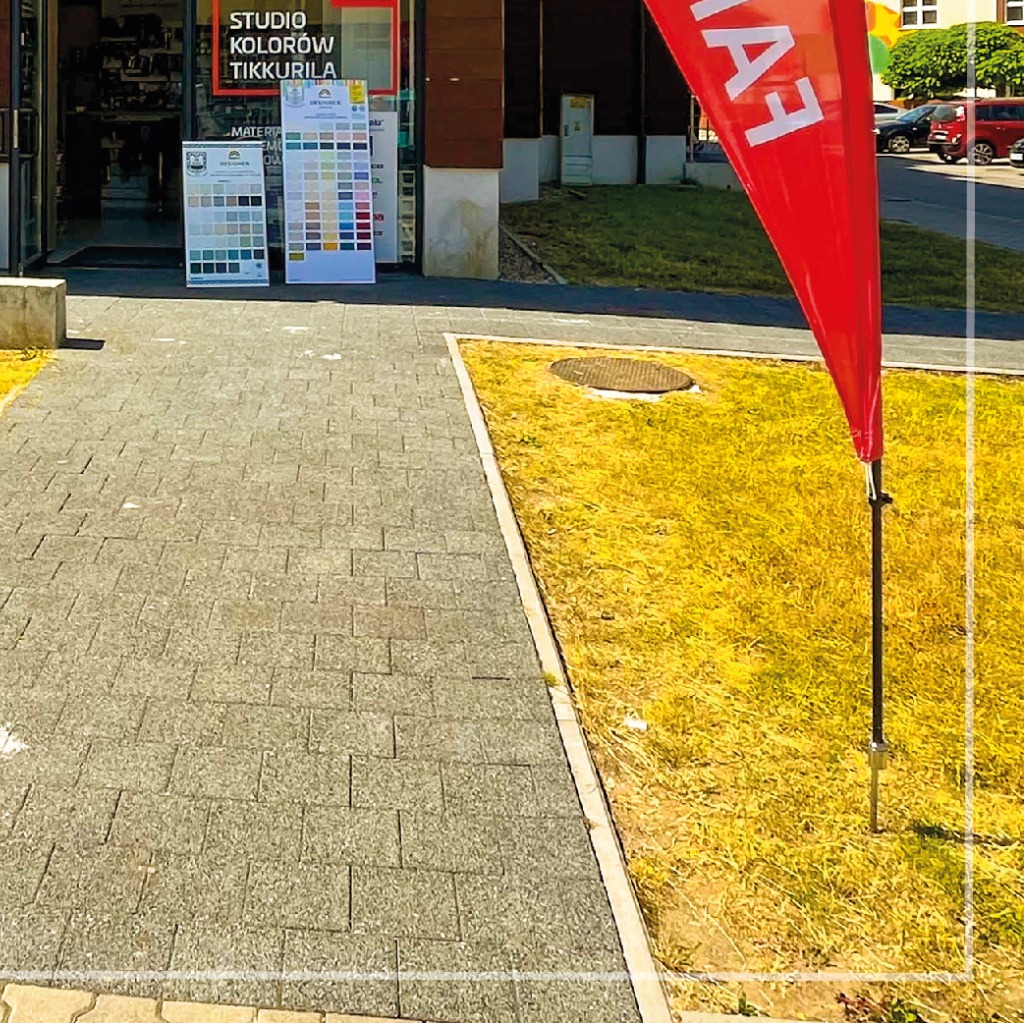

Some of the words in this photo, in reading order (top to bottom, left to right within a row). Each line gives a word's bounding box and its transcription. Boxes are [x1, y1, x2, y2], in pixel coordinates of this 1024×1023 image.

[229, 11, 307, 30] STUDIO
[229, 33, 335, 54] KOLORÓW
[229, 62, 337, 80] TIKKURILA
